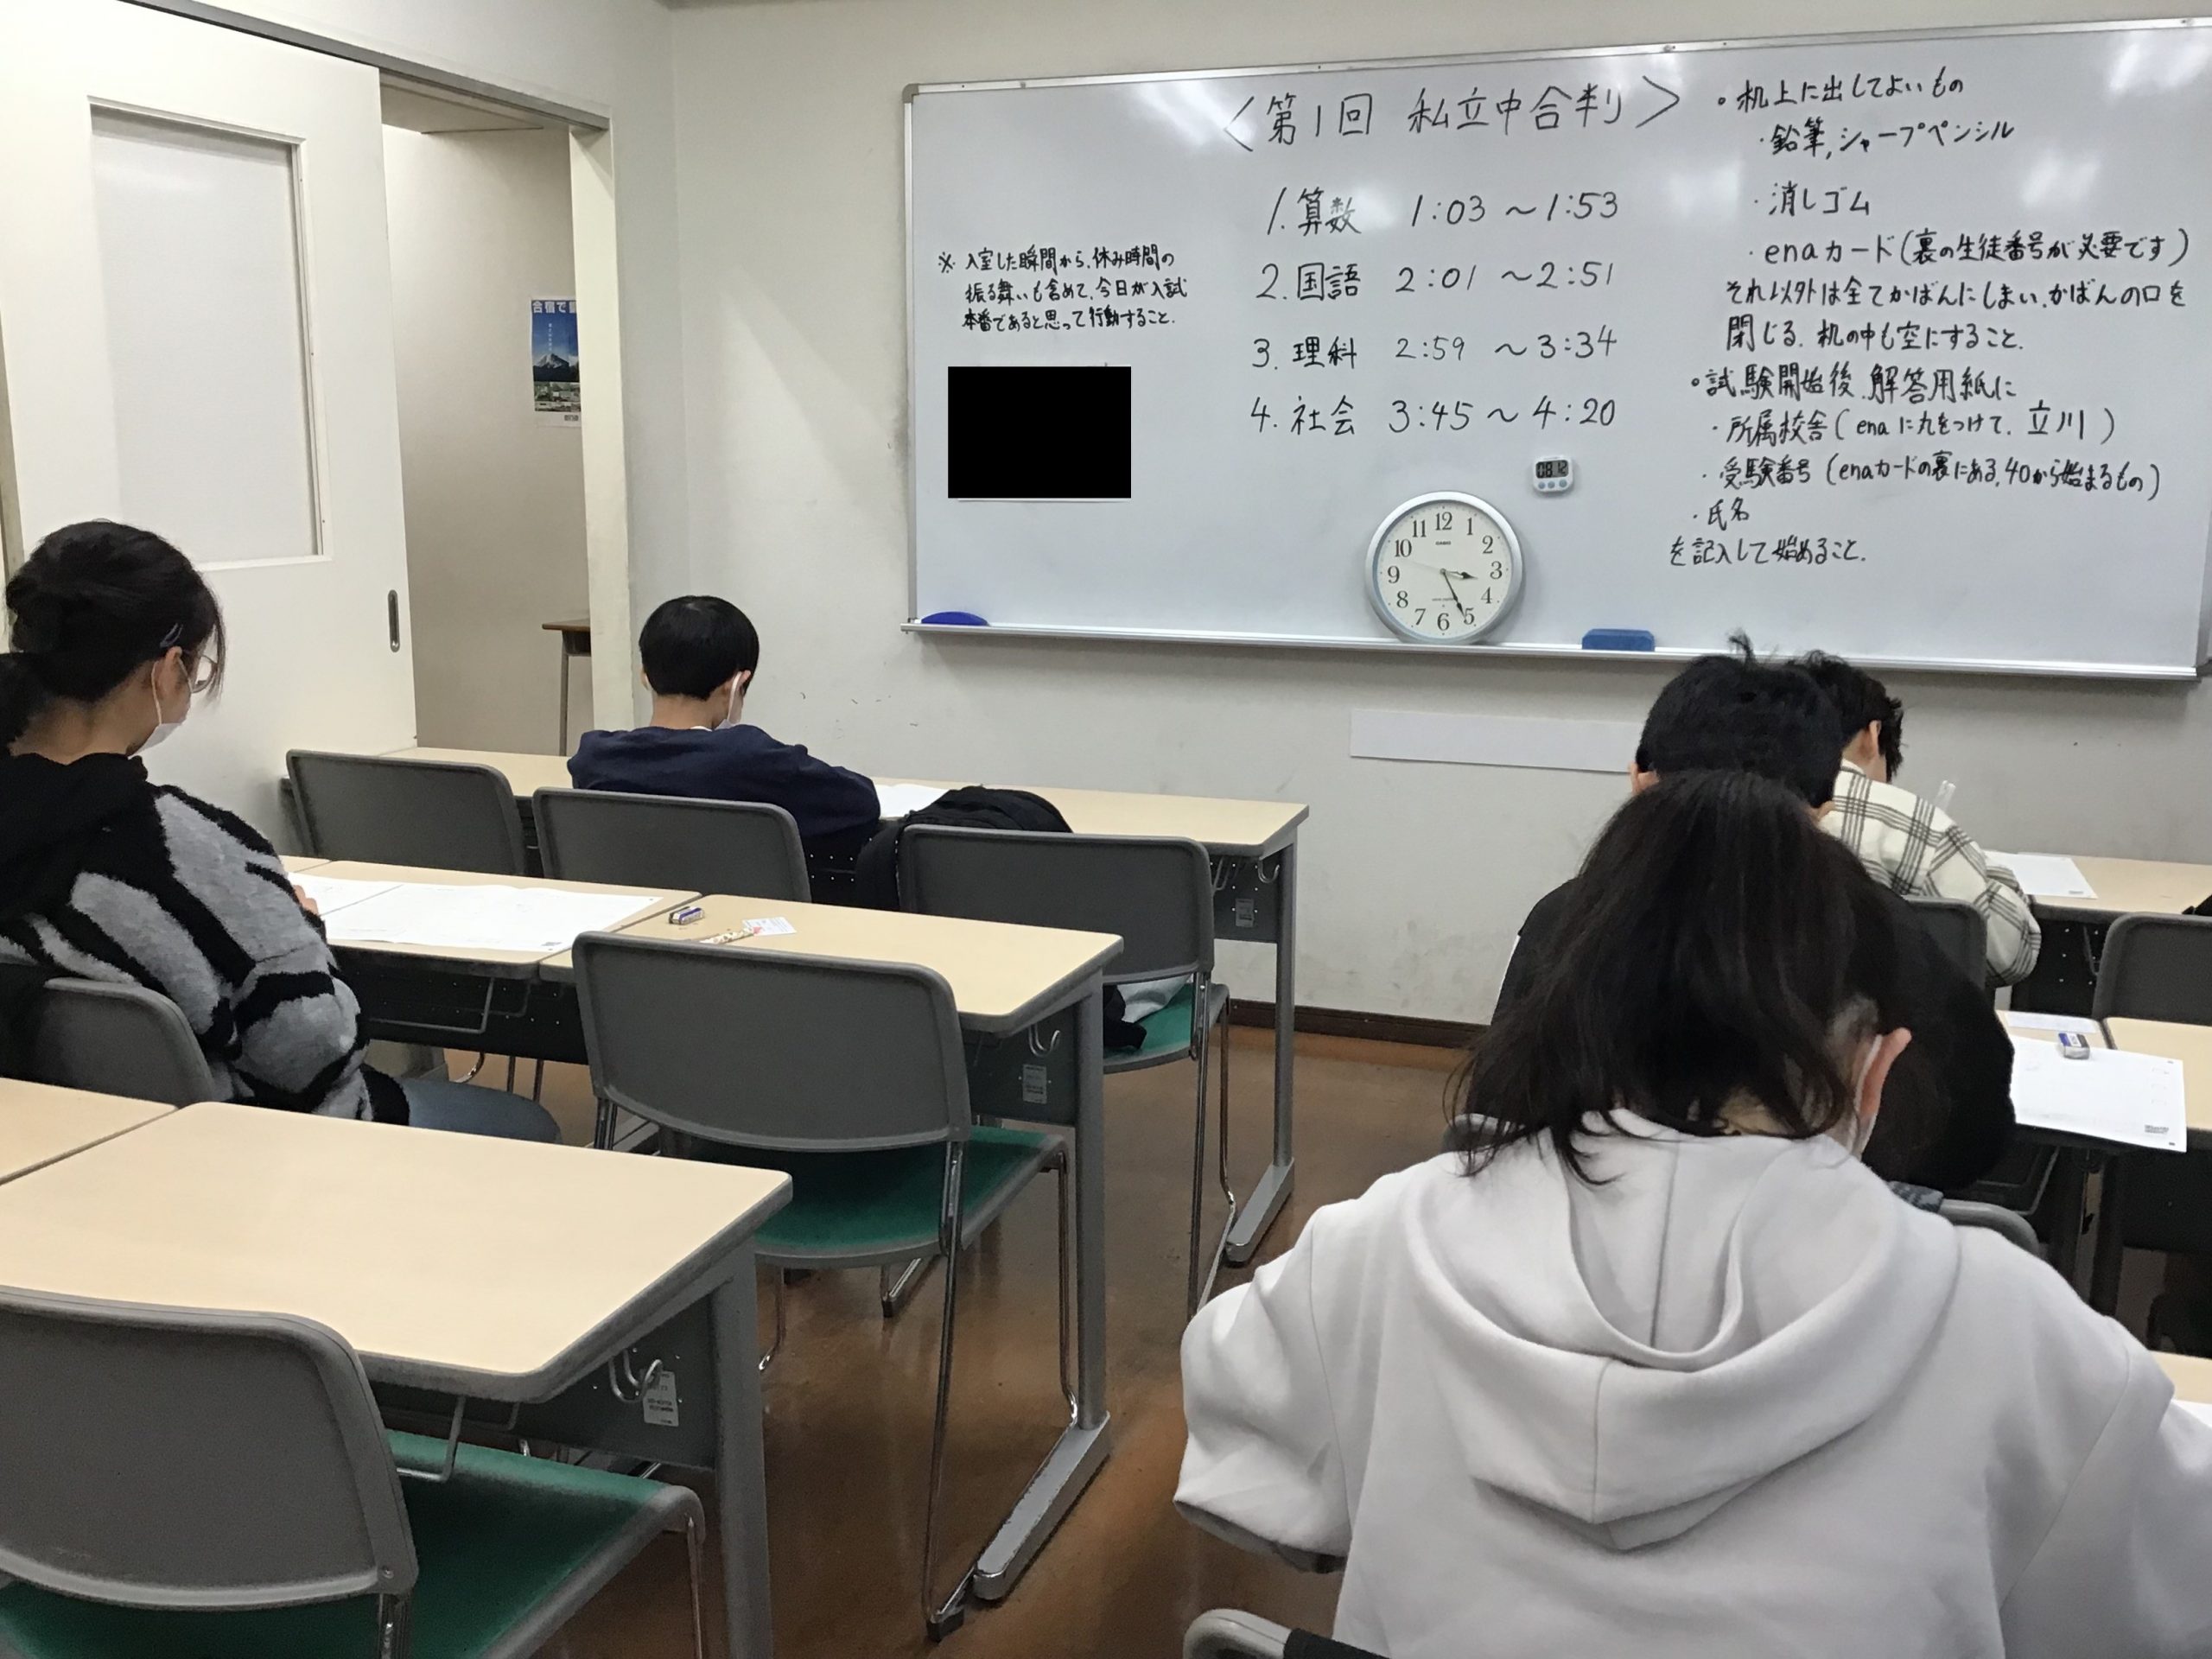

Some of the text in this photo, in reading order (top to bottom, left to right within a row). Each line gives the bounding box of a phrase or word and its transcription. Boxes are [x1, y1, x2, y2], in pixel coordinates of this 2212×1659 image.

[1412, 519, 1427, 537] 11
[1435, 512, 1452, 531] 12
[1466, 518, 1473, 536] 1
[1394, 538, 1413, 557] 10
[1482, 535, 1494, 554] 2
[1387, 565, 1400, 583] 9
[1490, 561, 1503, 580] 3
[1396, 590, 1408, 608] 8
[1481, 587, 1492, 604] 4
[1414, 608, 1427, 626] 7
[1437, 613, 1450, 631] 6
[1464, 607, 1475, 626] 5
